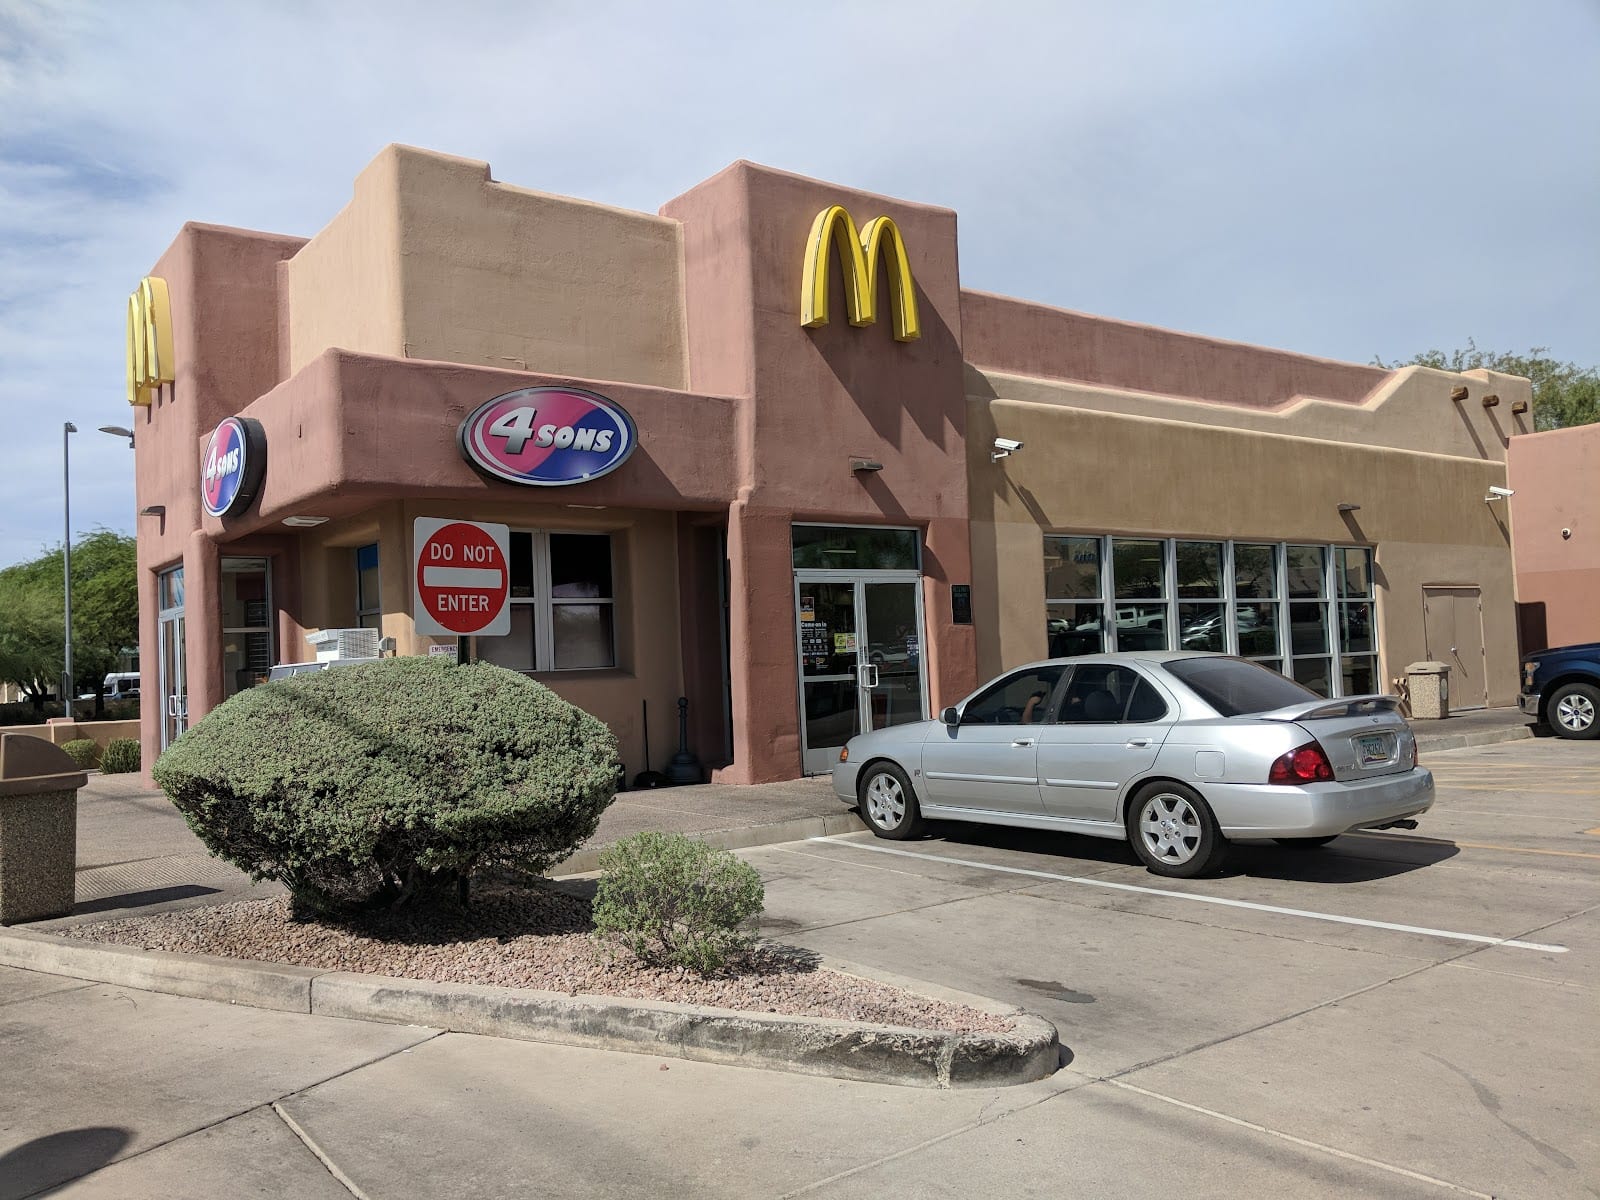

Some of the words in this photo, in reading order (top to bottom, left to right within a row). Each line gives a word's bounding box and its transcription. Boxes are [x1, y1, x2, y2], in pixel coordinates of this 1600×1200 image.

[488, 406, 537, 455] 4
[535, 424, 615, 453] SONS
[206, 446, 219, 493] 4
[216, 448, 240, 480] SONS
[430, 542, 454, 561] DO
[463, 544, 495, 563] NOT
[437, 594, 490, 612] ENTER
